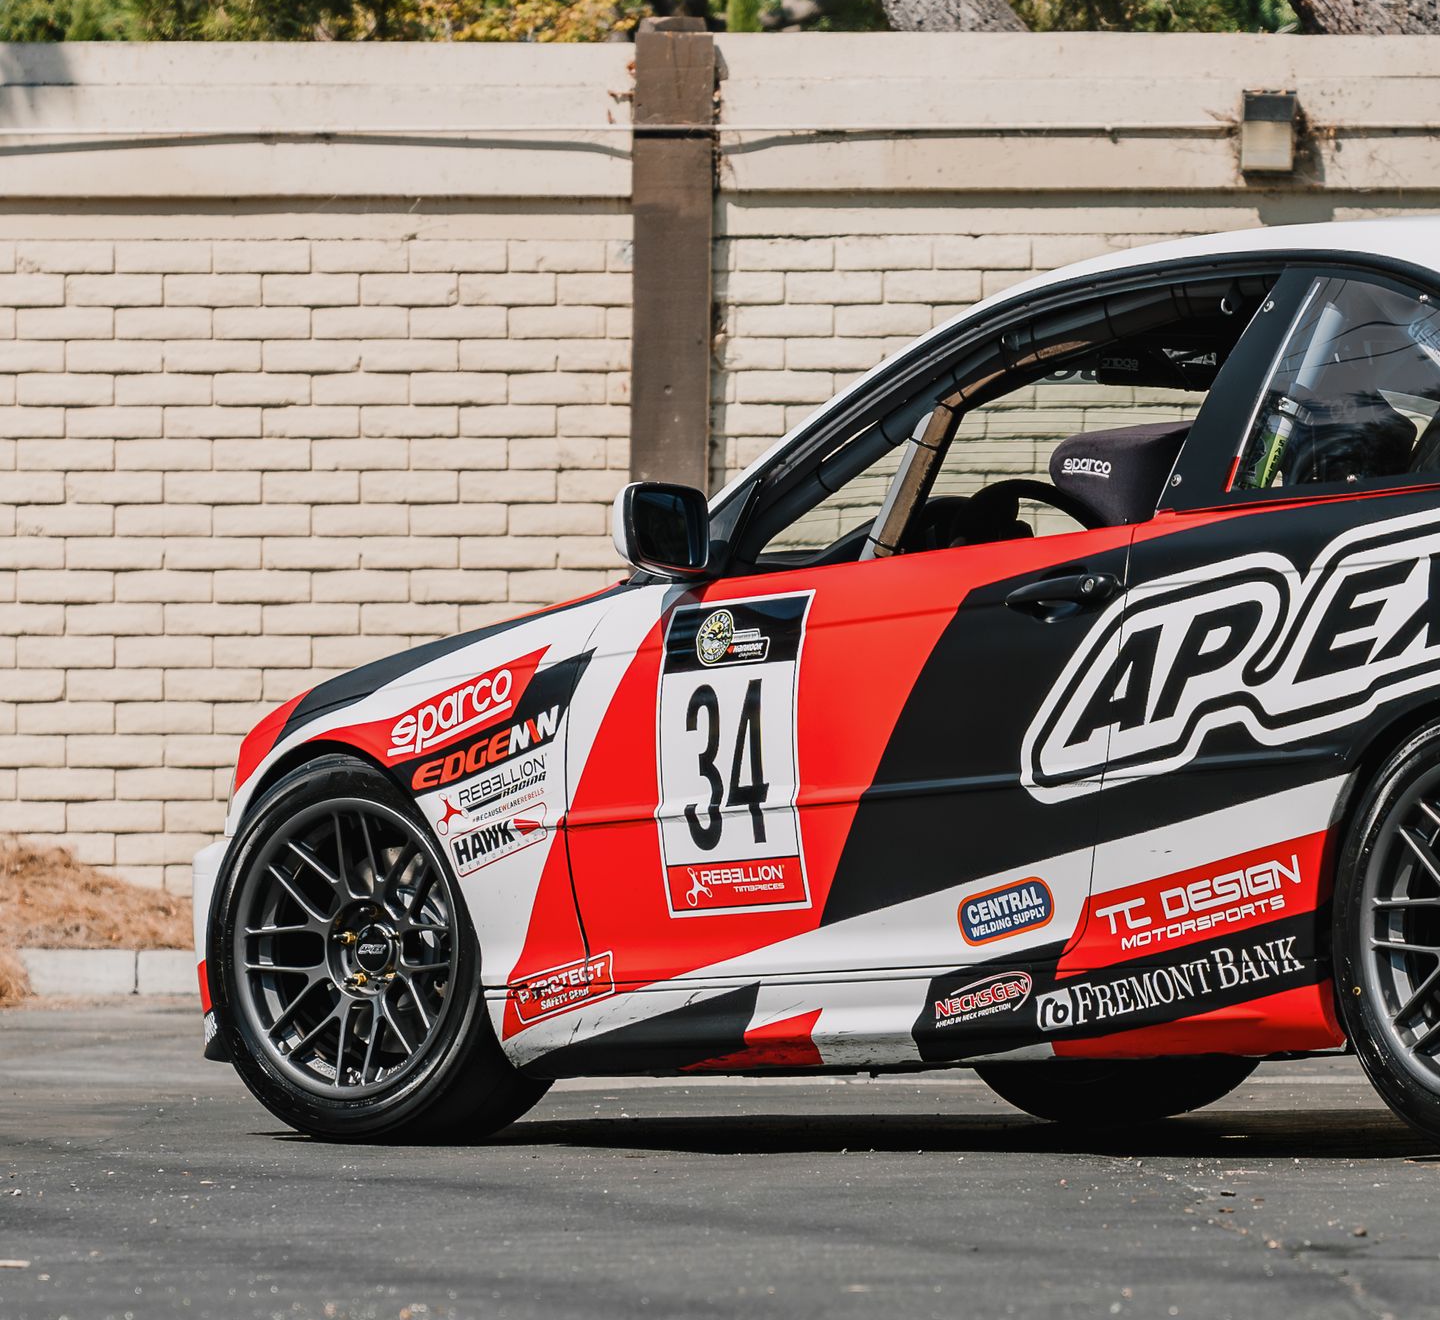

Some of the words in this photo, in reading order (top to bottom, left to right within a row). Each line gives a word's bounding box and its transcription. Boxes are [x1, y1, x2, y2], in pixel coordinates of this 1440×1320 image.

[1062, 458, 1112, 476] sparco
[387, 669, 513, 756] sparco
[459, 754, 546, 806] REBELLION
[685, 678, 770, 851] 34
[453, 819, 516, 866] HAWK
[701, 864, 784, 886] REBELLION
[1096, 897, 1152, 935] TC
[1159, 854, 1302, 920] DESIGN
[967, 886, 1043, 925] CENTRAL
[971, 919, 1012, 938] WELDING
[1013, 906, 1045, 925] SUPPLY
[1121, 894, 1286, 951] MOTORSPORTS
[541, 993, 568, 1010] SAFETY
[1071, 958, 1212, 1025] FREMONT
[1210, 936, 1305, 990] BANK
[936, 1017, 955, 1028] AHEAD
[962, 1012, 978, 1021] NECK
[978, 1002, 1012, 1018] PROTECTION
